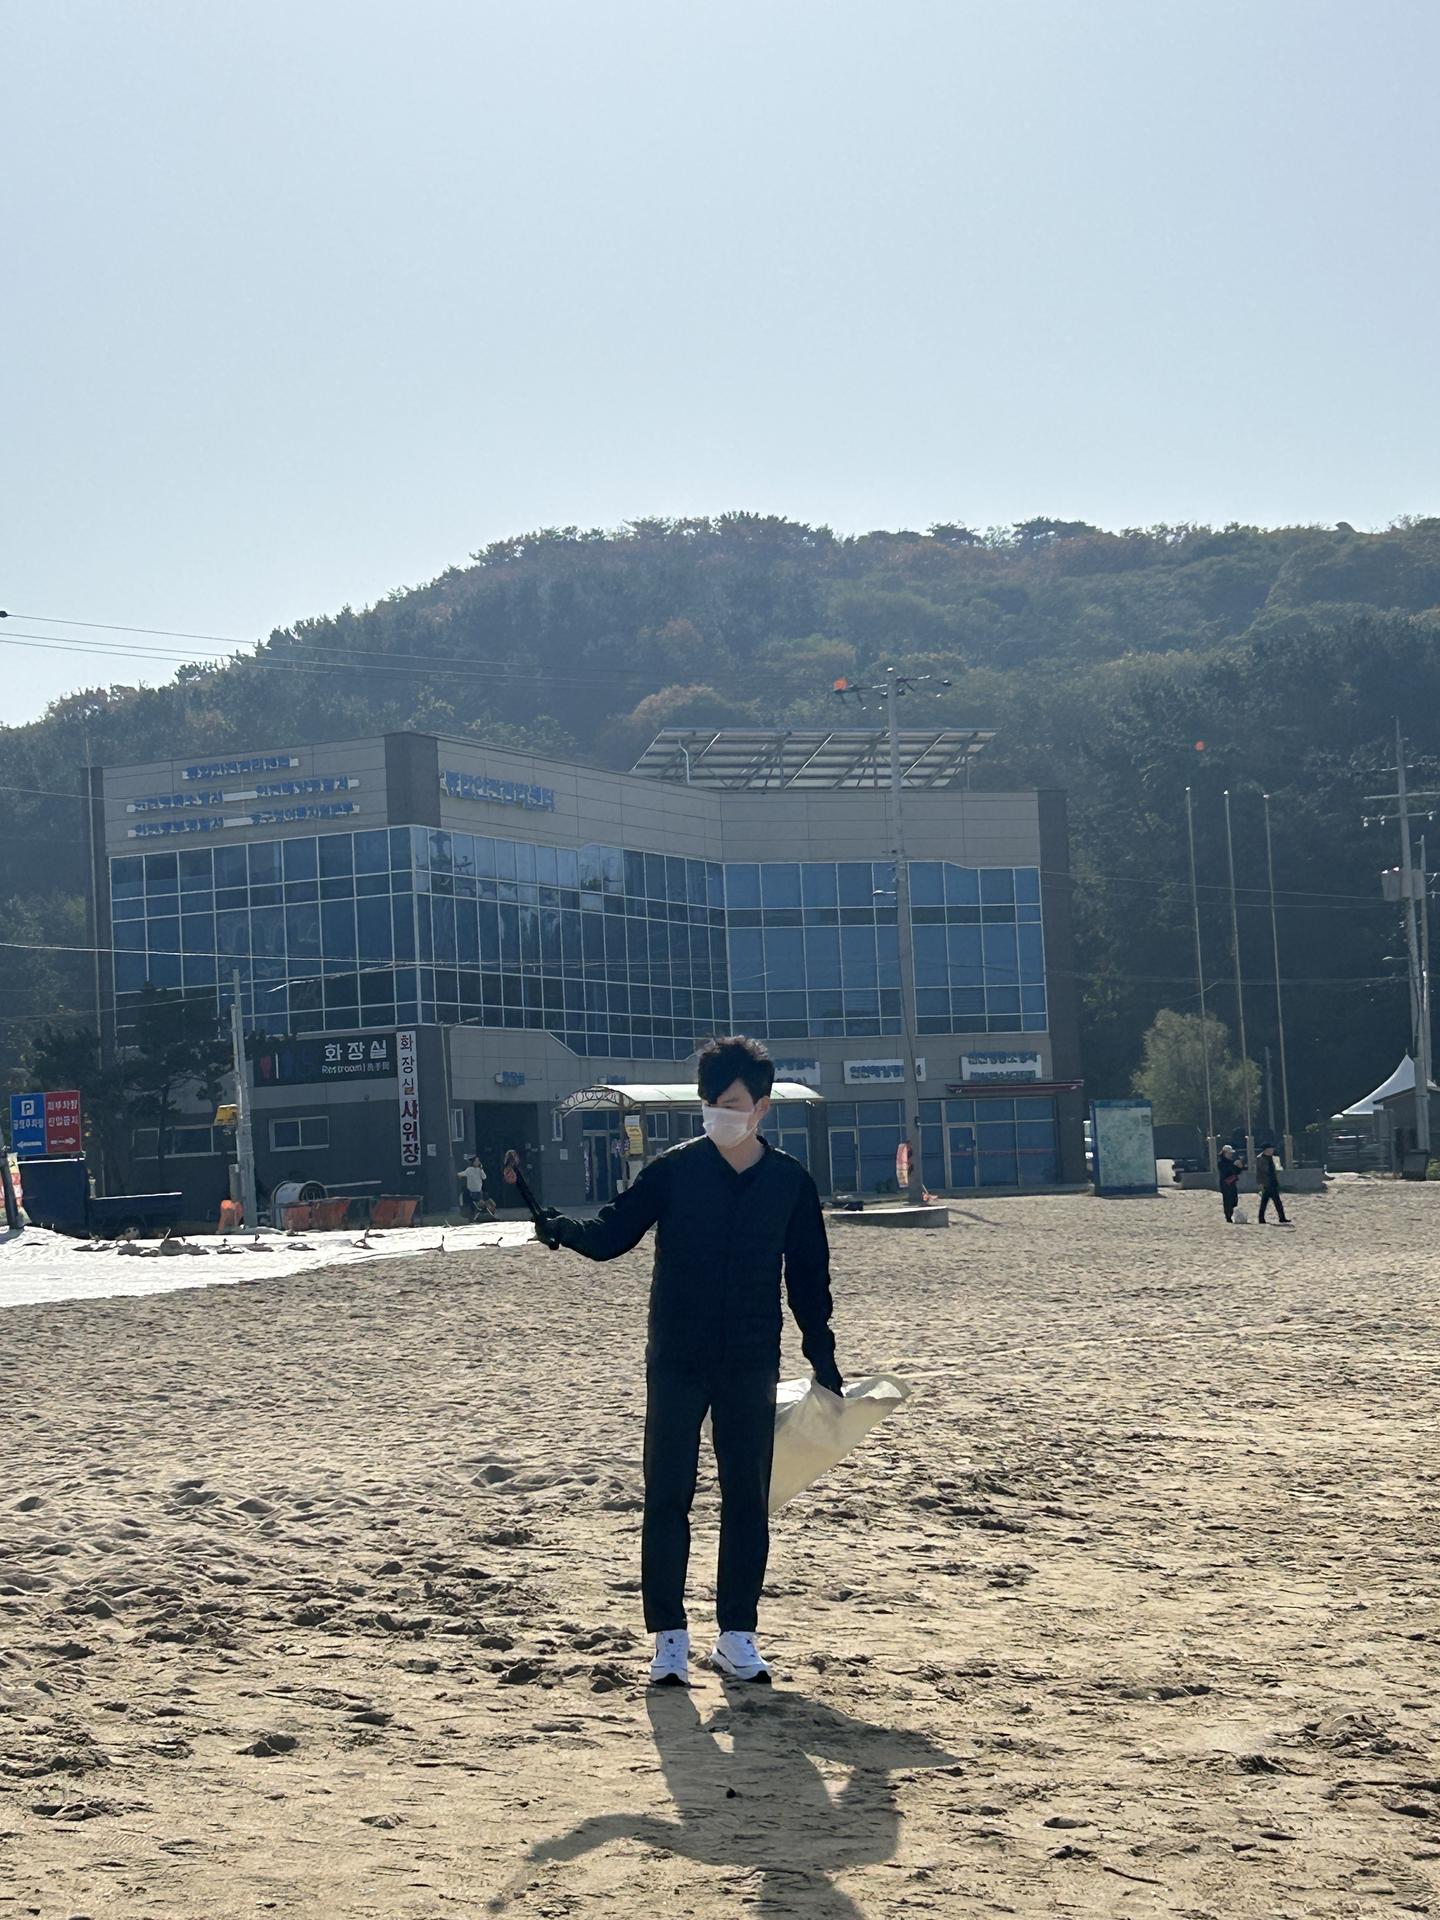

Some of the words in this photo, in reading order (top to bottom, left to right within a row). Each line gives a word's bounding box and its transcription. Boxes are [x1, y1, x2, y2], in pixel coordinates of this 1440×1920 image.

[324, 1039, 387, 1062] 화장실
[400, 1034, 415, 1096] 화장실
[24, 1103, 32, 1114] P
